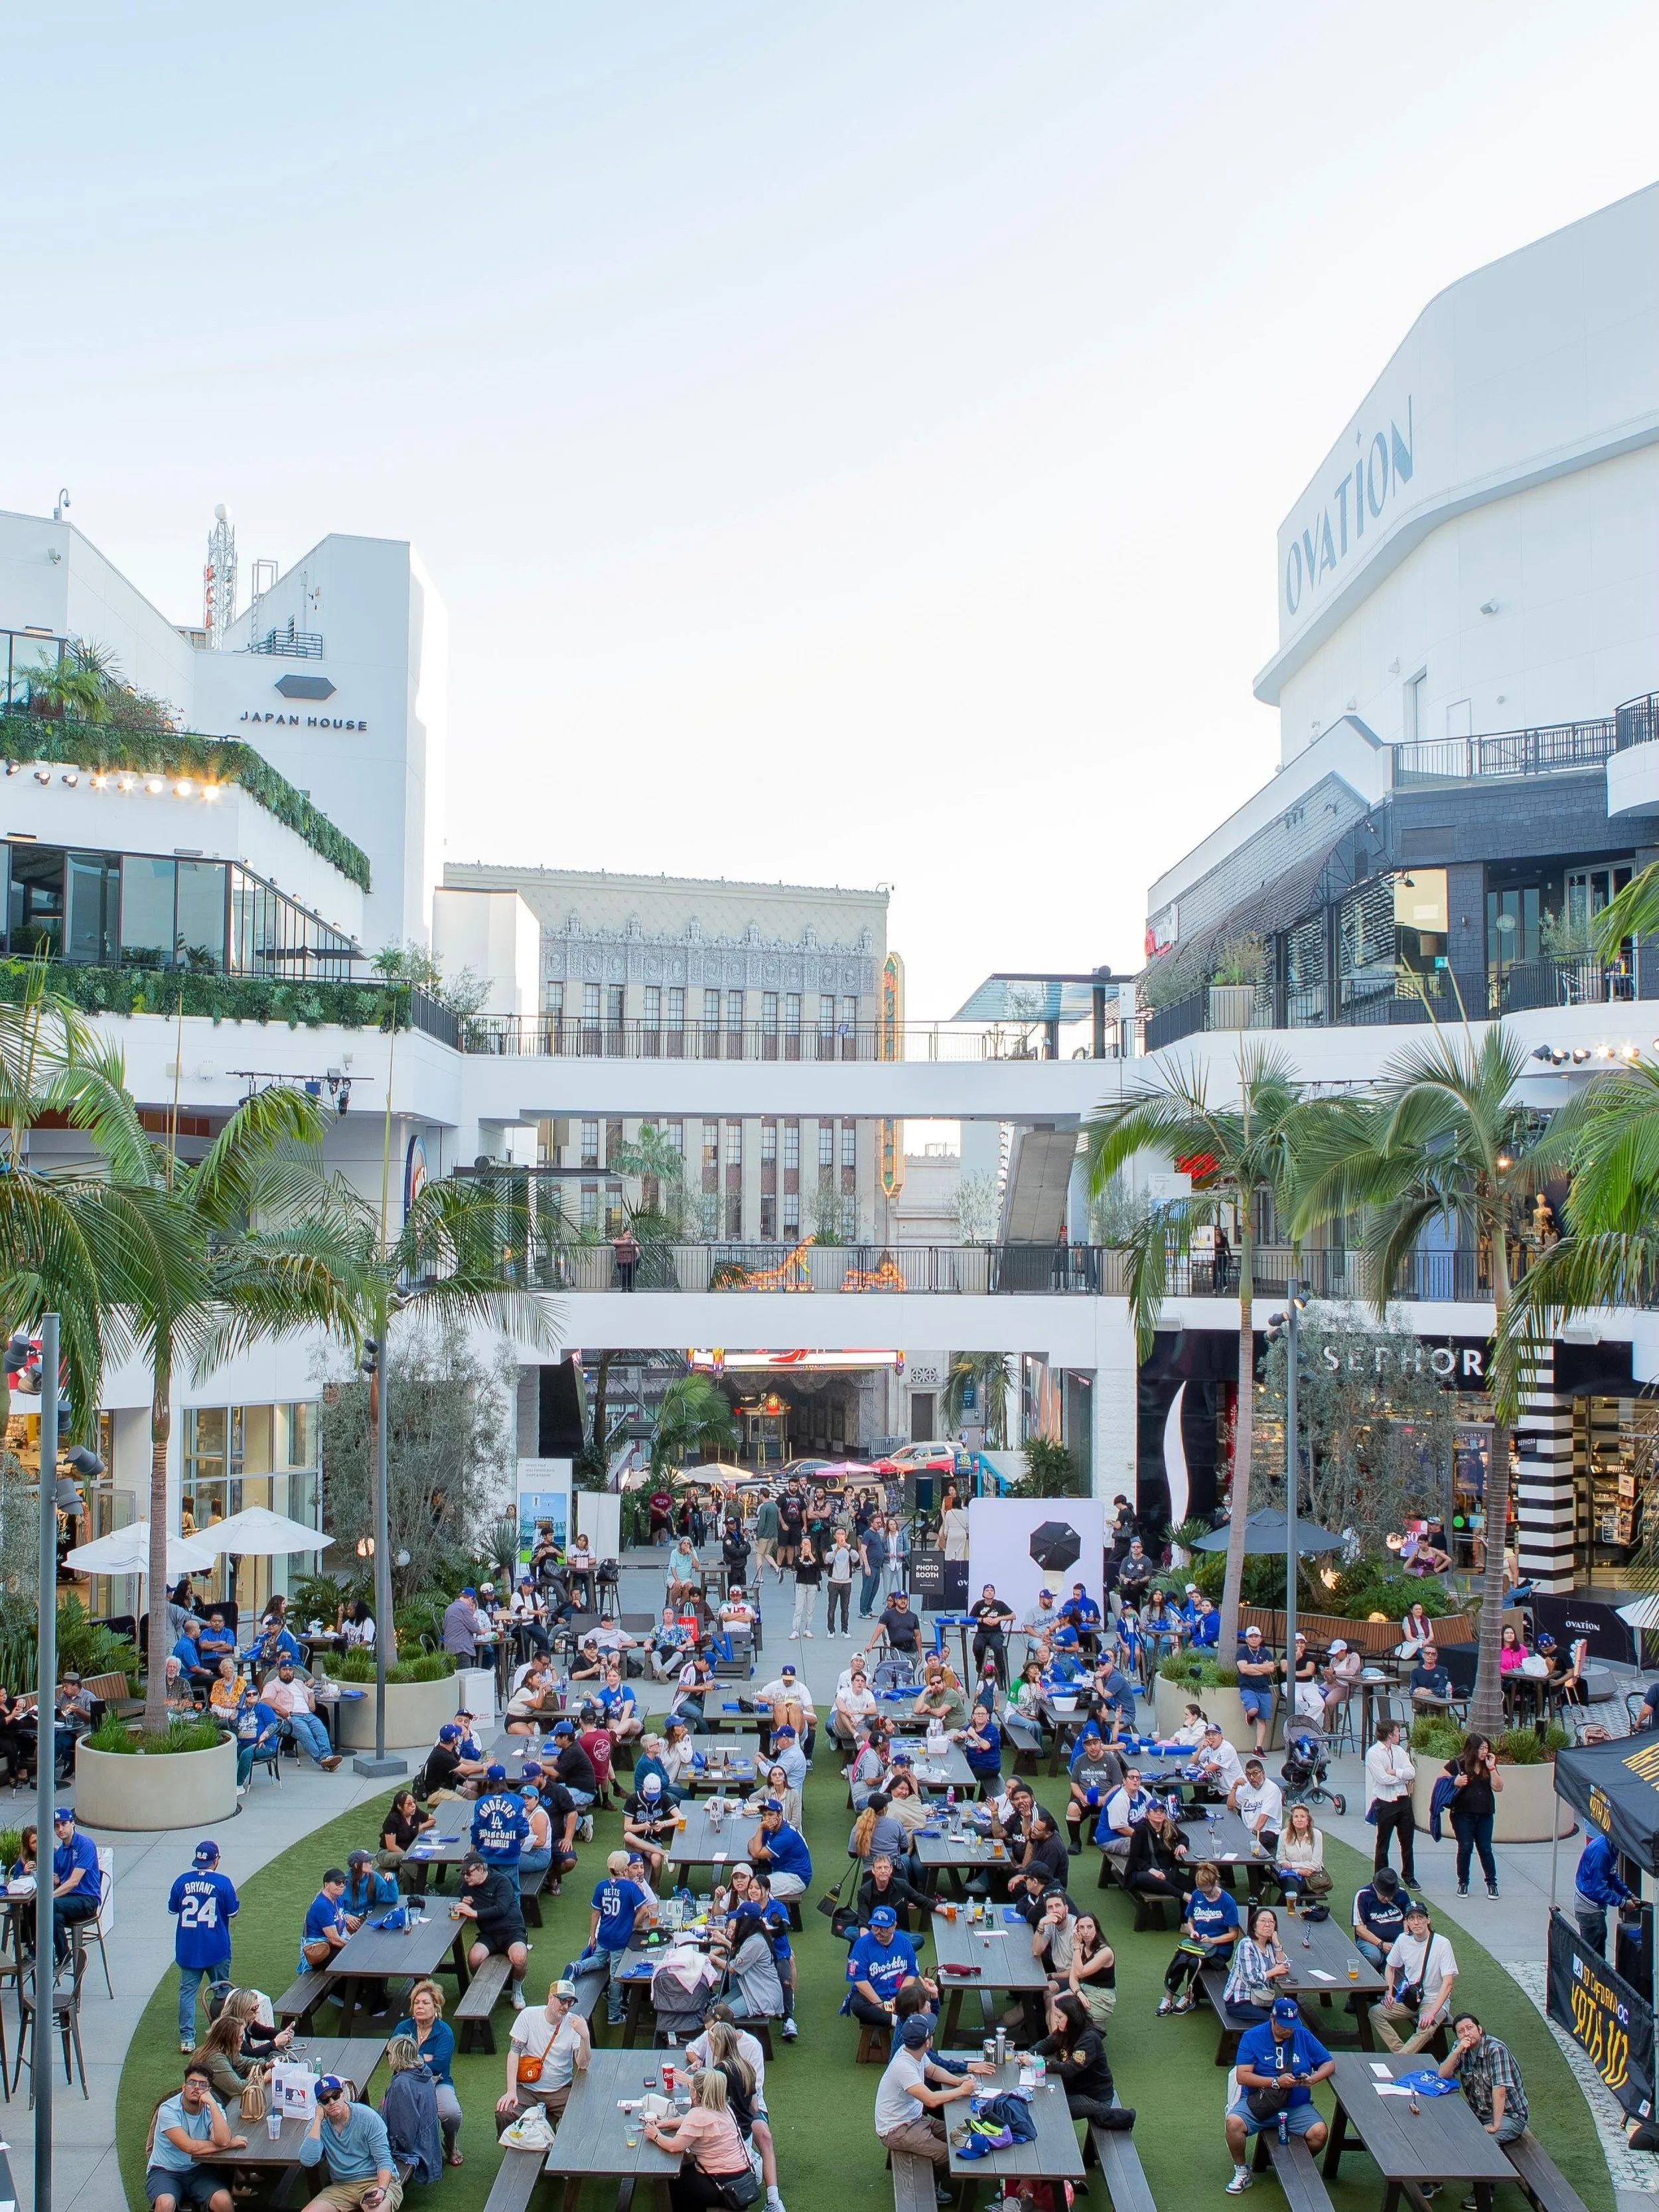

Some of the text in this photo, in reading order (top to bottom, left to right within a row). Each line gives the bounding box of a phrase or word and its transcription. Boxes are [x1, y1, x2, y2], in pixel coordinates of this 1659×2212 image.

[1285, 394, 1414, 616] OVATION
[240, 711, 368, 731] JAPAN HOUSE
[1323, 1345, 1496, 1376] SEPHOR
[1565, 1620, 1601, 1631] OVATION
[479, 1799, 516, 1818] DODGERS
[491, 1812, 502, 1828] LA
[491, 1840, 510, 1848] ANGELES
[184, 1881, 216, 1895] BRYANT
[604, 1888, 620, 1897] BETTS
[181, 1895, 218, 1928] 24
[602, 1897, 621, 1916] 50
[1194, 1907, 1223, 1921] Dodgers
